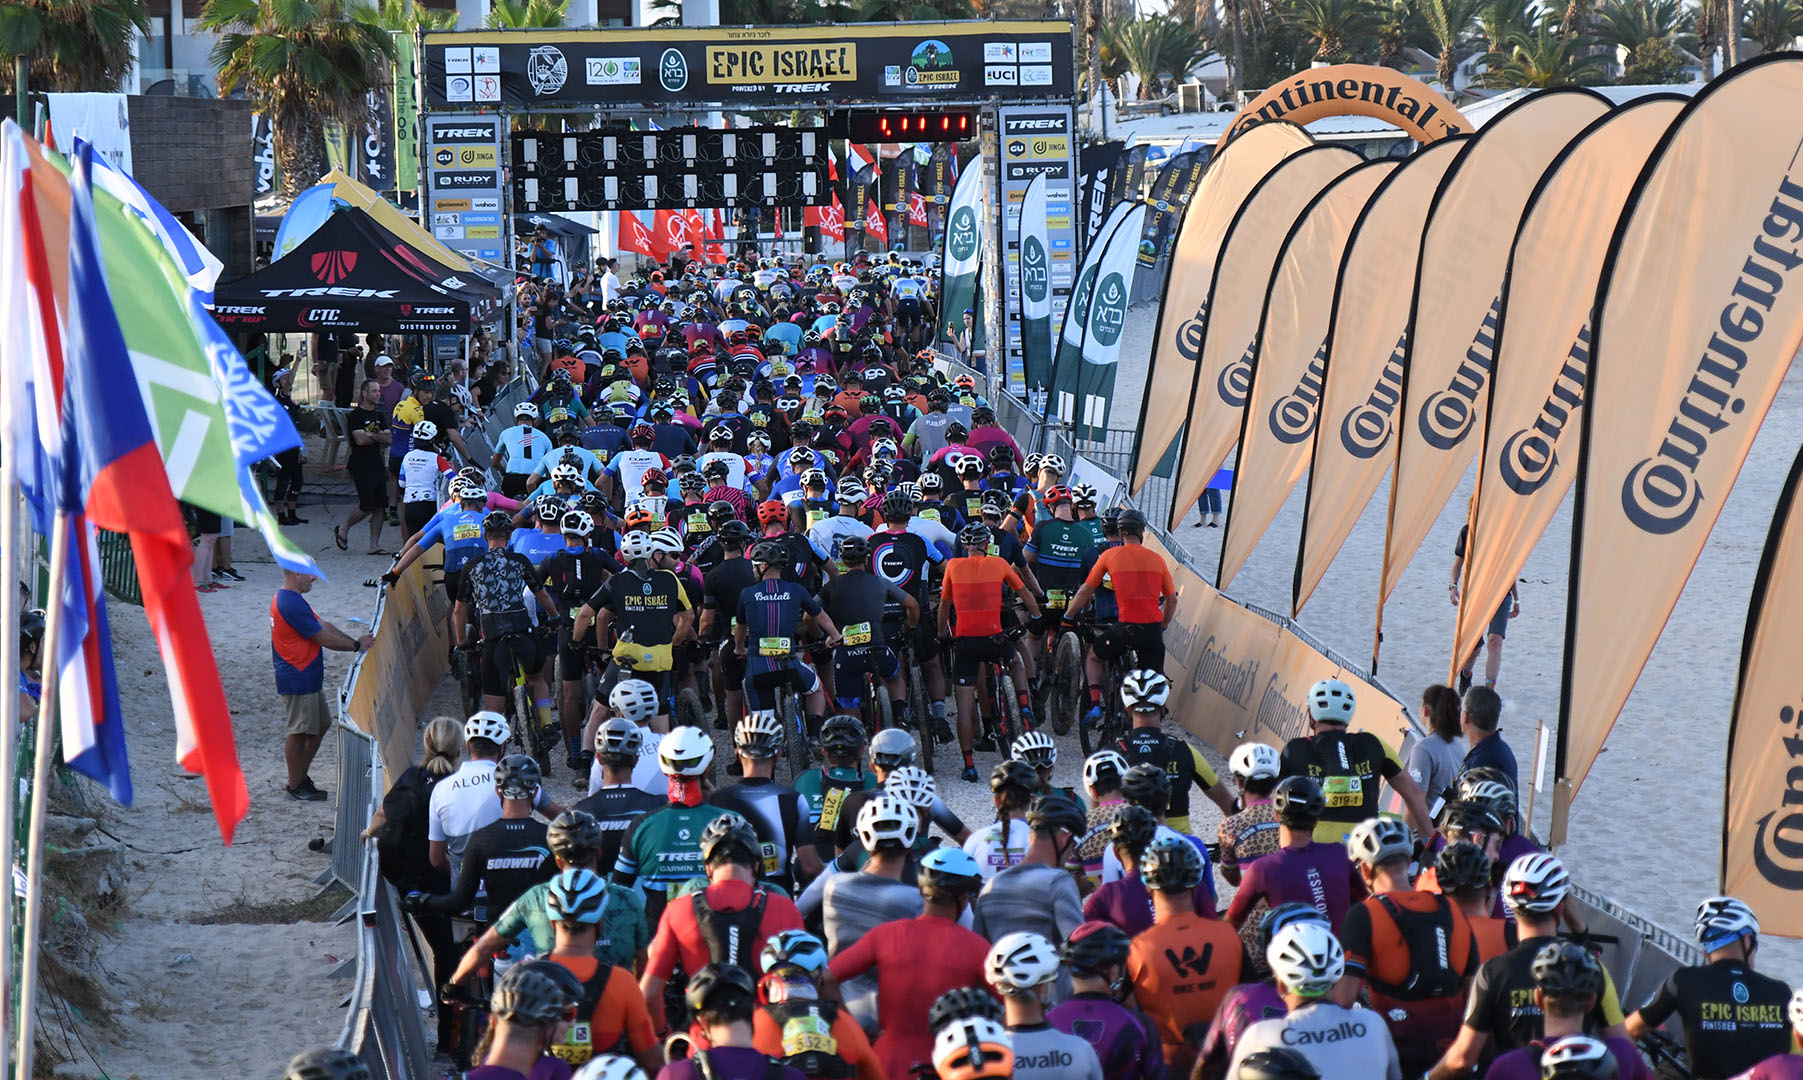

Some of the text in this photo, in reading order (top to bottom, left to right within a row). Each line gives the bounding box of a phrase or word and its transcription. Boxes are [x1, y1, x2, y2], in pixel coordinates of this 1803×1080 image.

[713, 48, 850, 78] EPIC ISRAEL
[664, 68, 684, 78] ברא
[918, 71, 959, 82] EPIC ISRAEL
[992, 70, 1015, 80] UCI
[773, 83, 831, 93] TREK
[1007, 119, 1065, 129] TREK
[434, 128, 493, 138] TREK
[260, 287, 400, 298] TREK
[215, 305, 266, 314] TREK
[308, 309, 340, 321] CTC
[1050, 543, 1080, 552] TREK
[625, 594, 667, 606] EPIC ISRAEL
[754, 592, 791, 601] Bartali
[452, 773, 491, 790] ALON
[1332, 796, 1359, 806] 319-1
[823, 797, 837, 824] 213-1
[1435, 927, 1448, 970] USWE
[1511, 990, 1534, 1007] EPI
[1702, 1003, 1783, 1022] EPIC ISRAEL
[1702, 1020, 1737, 1031] FINISHER
[1280, 1020, 1367, 1046] Cavallo
[1013, 1049, 1073, 1069] avallo
